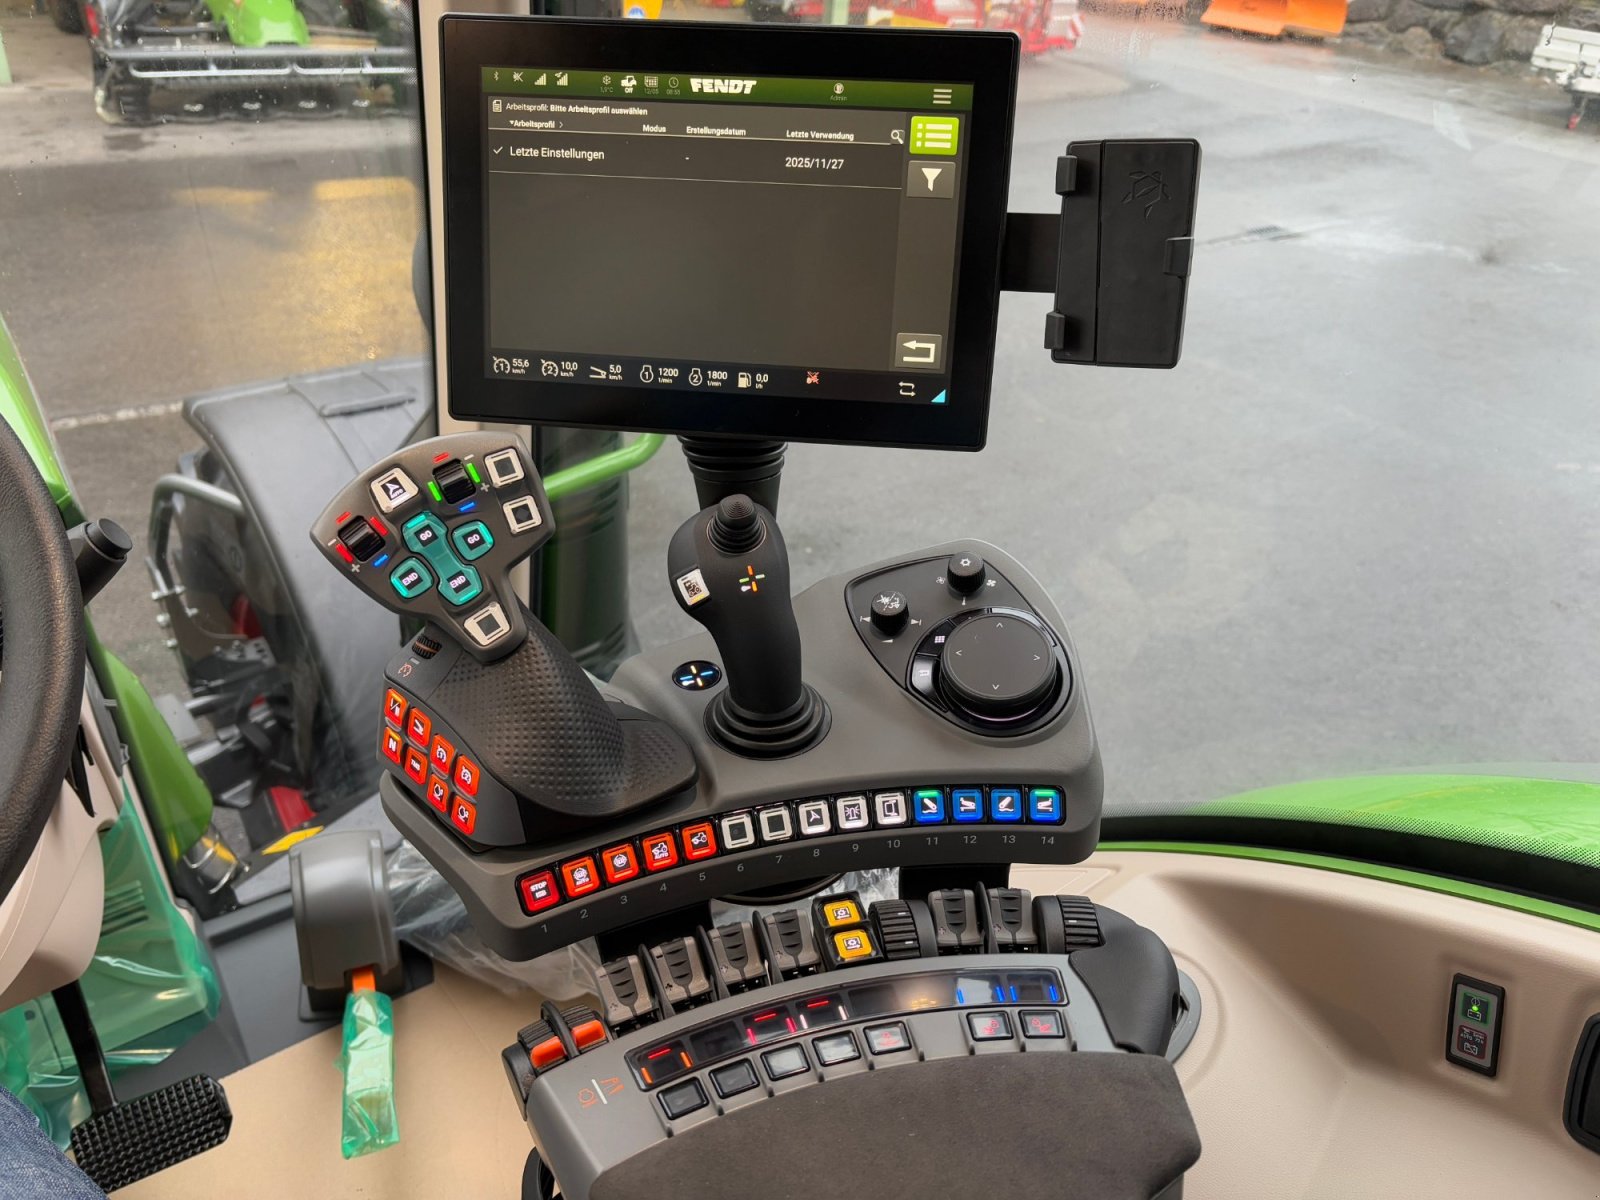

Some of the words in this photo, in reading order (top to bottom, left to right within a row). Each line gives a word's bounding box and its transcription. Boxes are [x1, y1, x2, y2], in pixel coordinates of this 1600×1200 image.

[690, 78, 757, 94] FENDT
[506, 102, 549, 112] Arbeitsprofil:
[550, 104, 567, 112] Bitte
[568, 105, 610, 115] Arbeitsprofil
[611, 106, 648, 116] auswählen
[514, 120, 556, 130] Arbeitsprofil
[642, 124, 666, 133] Modus
[686, 126, 746, 137] Erstellungsdatum
[786, 130, 809, 139] Letzte
[810, 130, 854, 142] Verwendung
[510, 146, 539, 158] Letzte
[541, 148, 605, 162] Einstellungen
[785, 157, 844, 170] 2025/11/27
[512, 358, 530, 368] 55,6
[561, 362, 578, 371] 10,0
[610, 364, 622, 374] 5,0
[658, 368, 678, 377] 1200
[707, 370, 728, 380] 1800
[756, 374, 768, 384] 0,0
[420, 530, 433, 542] GO
[467, 534, 480, 544] GO
[402, 572, 418, 586] END
[450, 575, 466, 588] END
[388, 738, 396, 752] N
[887, 839, 900, 848] 10
[926, 837, 939, 846] 11
[964, 835, 977, 845] 12
[1002, 835, 1016, 844] 13
[1040, 836, 1055, 845] 14
[813, 849, 820, 857] 8
[852, 844, 859, 852] 9
[654, 851, 668, 860] AUTO
[776, 855, 784, 864] 7
[737, 863, 744, 872] 6
[699, 872, 706, 881] 5
[530, 881, 547, 892] STOP
[659, 883, 667, 892] 4
[620, 895, 628, 904] 3
[580, 908, 588, 919] 2
[540, 924, 548, 934] 1
